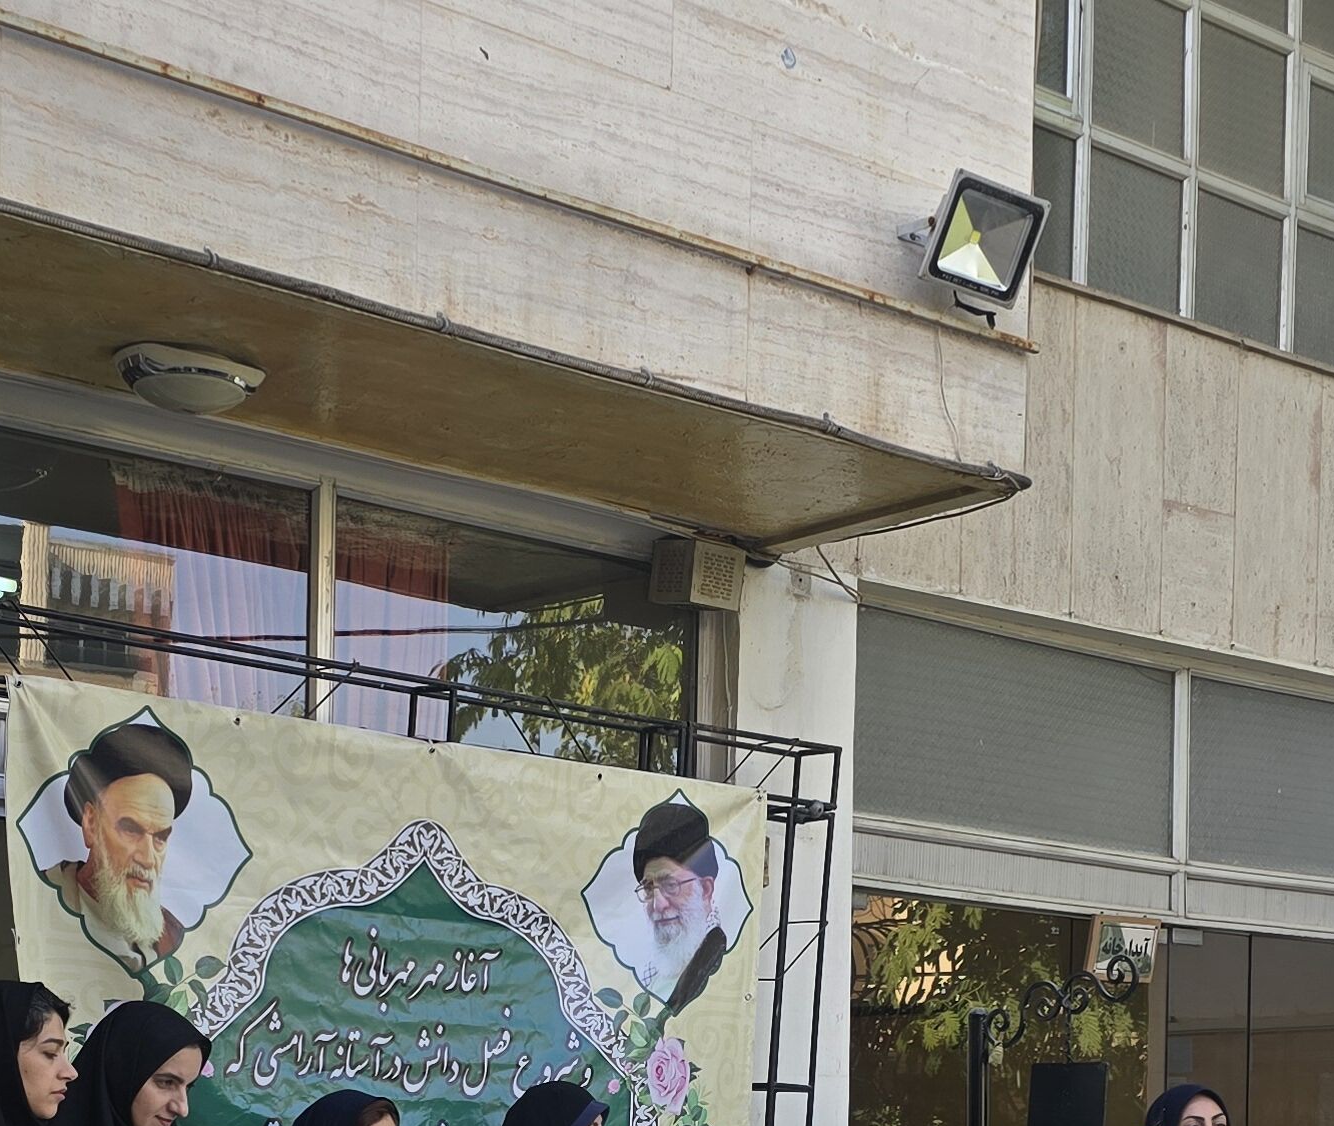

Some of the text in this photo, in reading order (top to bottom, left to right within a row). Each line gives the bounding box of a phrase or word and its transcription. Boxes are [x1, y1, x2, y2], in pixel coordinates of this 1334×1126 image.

[407, 961, 445, 1001] مهر
[444, 949, 502, 993] آغاز
[225, 999, 279, 1076] که
[253, 1011, 339, 1087] آرامشی
[329, 1029, 395, 1080] آستانه
[402, 1023, 460, 1094] دانش
[462, 1006, 512, 1097] فصل
[382, 1055, 403, 1081] در
[579, 1066, 593, 1089] و
